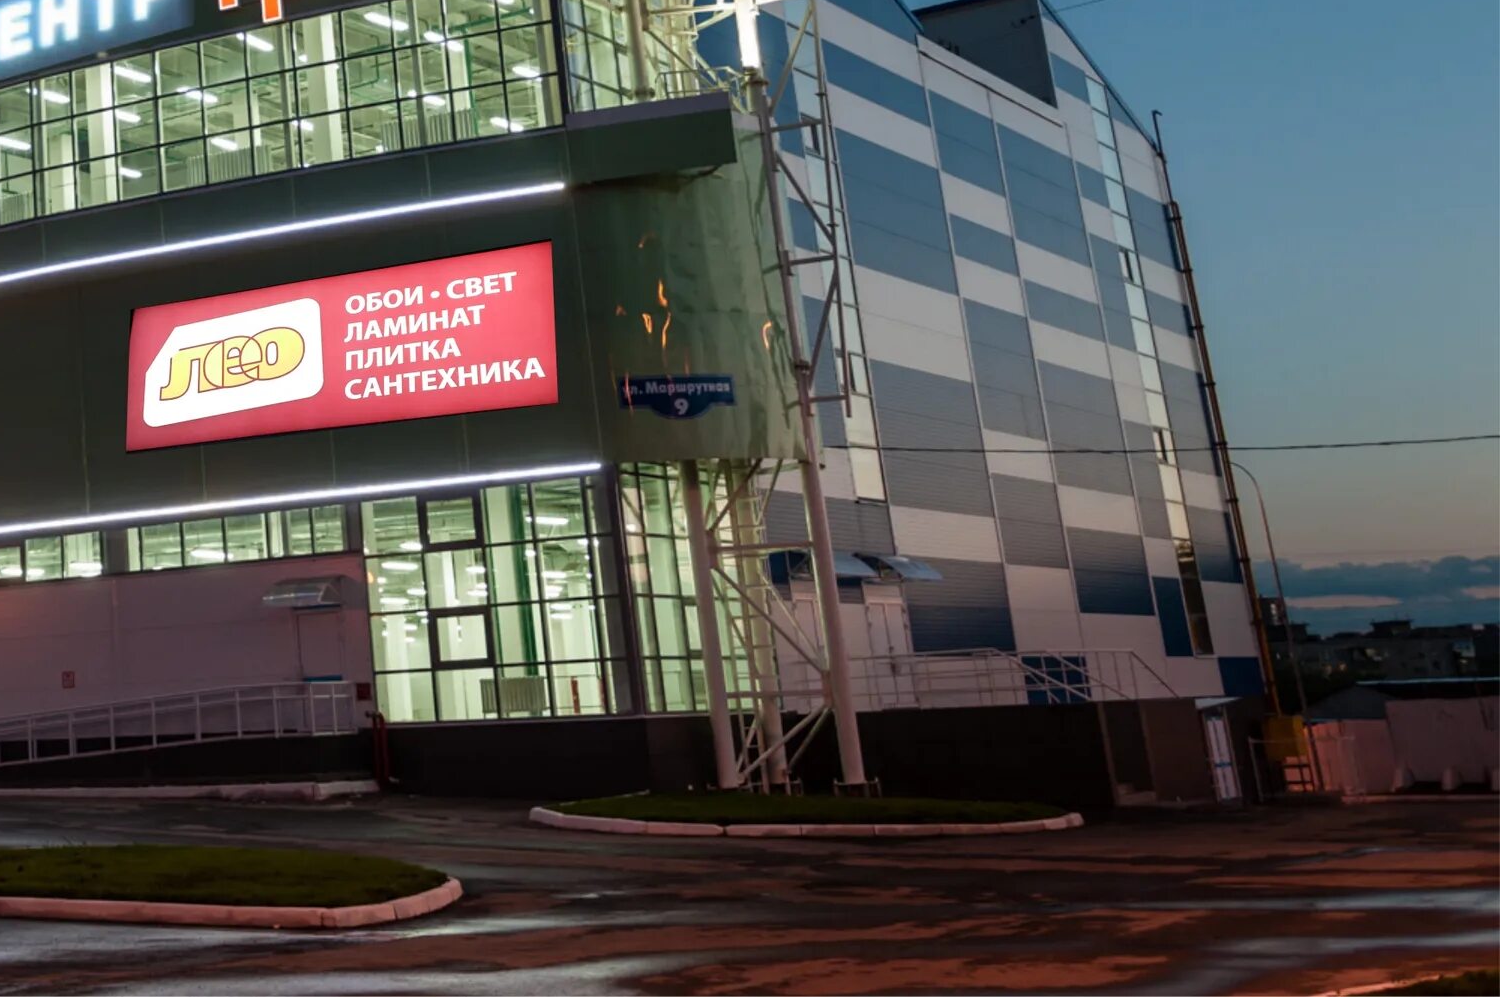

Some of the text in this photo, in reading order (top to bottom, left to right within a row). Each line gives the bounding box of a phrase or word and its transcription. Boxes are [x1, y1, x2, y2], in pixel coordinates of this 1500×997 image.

[344, 271, 517, 315] ОБОИ СВЕТ
[343, 304, 486, 343] ЛАМИНАТ
[344, 337, 462, 371] ПЛИТКА
[344, 357, 546, 401] САНТЕХНИКА
[645, 381, 731, 396] Маршрутная
[674, 398, 689, 415] 9
